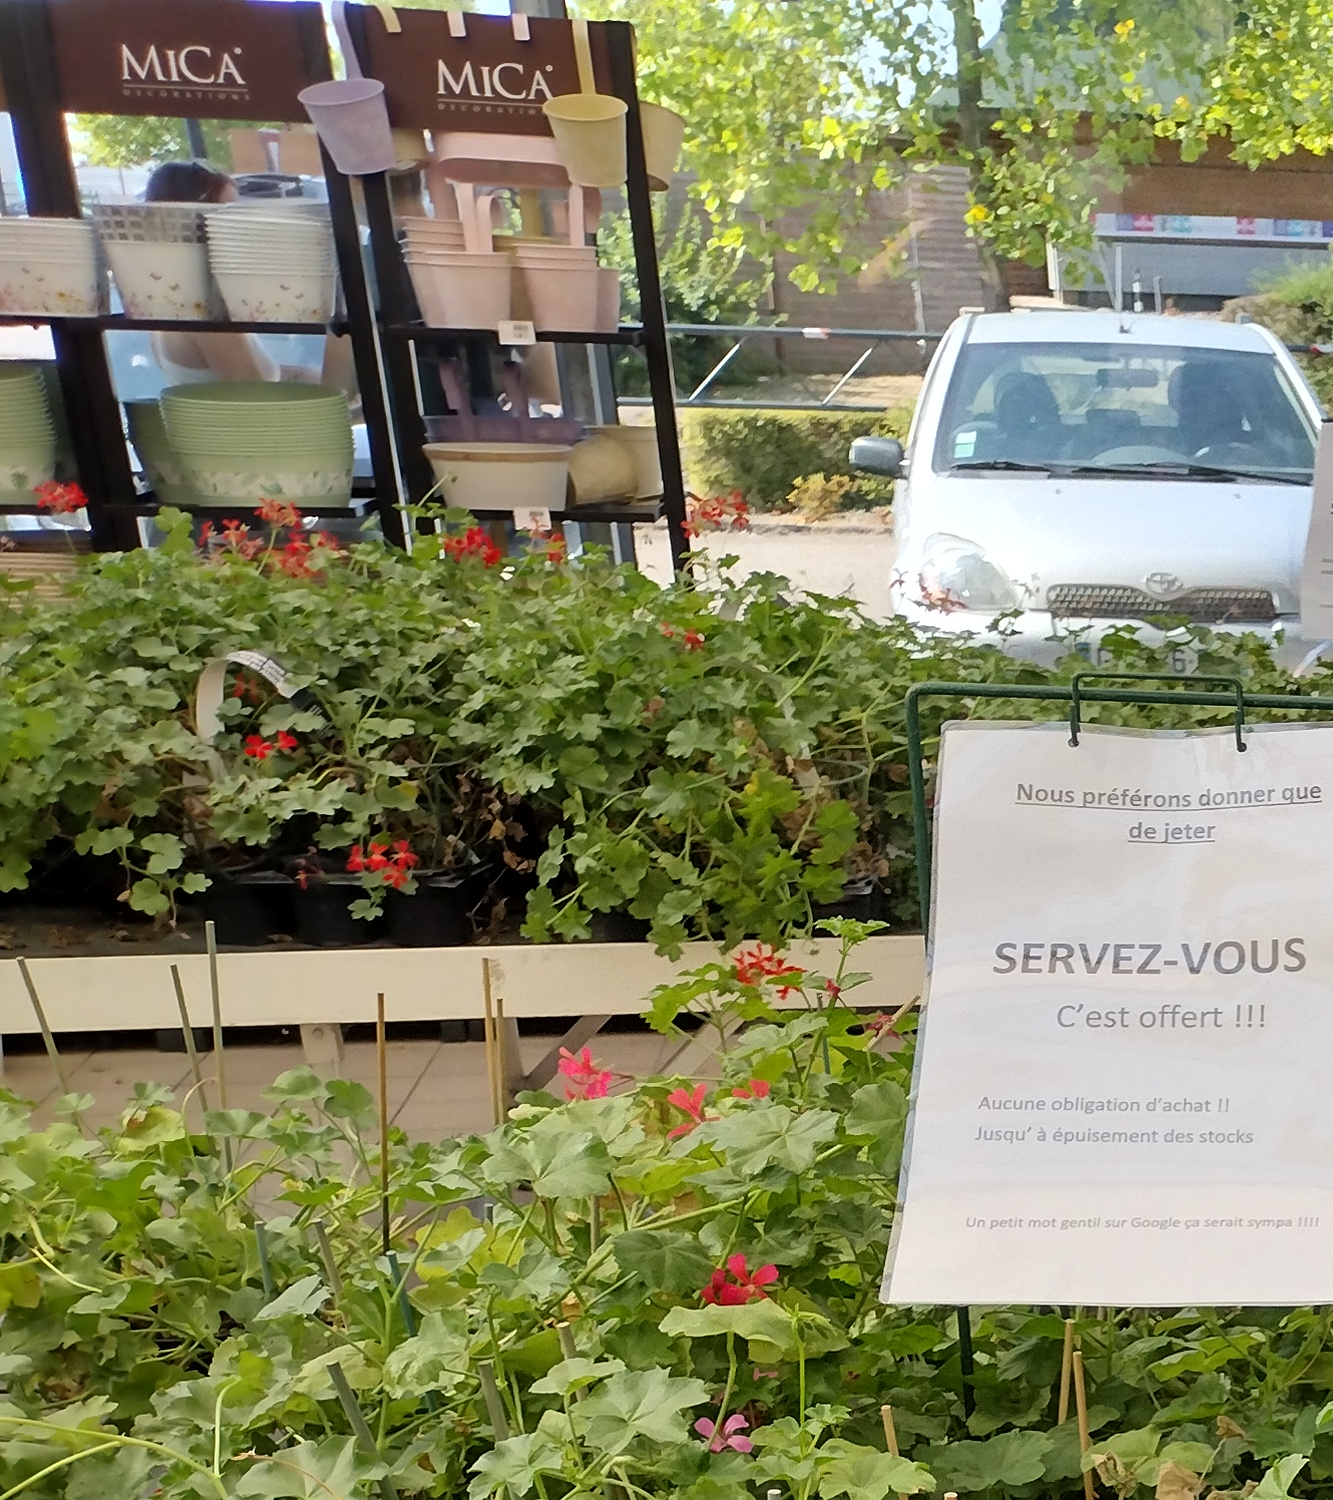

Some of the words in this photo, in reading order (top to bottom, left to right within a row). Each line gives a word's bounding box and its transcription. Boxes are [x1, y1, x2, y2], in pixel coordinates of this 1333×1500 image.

[1016, 783, 1074, 803] Nous
[1082, 787, 1191, 809] préférons
[1200, 786, 1275, 806] donner
[1281, 783, 1322, 803] que
[1128, 822, 1157, 839] de
[1162, 823, 1216, 842] jeter
[993, 937, 1307, 975] SERVEZ-VOUS
[1056, 1003, 1130, 1028] C'est
[1139, 1004, 1223, 1028] offert
[1235, 1004, 1266, 1028] !!!
[978, 1096, 1046, 1110] Aucune
[1051, 1097, 1140, 1114] obligation
[1146, 1097, 1211, 1113] d'achat
[1217, 1098, 1230, 1113] !!
[975, 1126, 1032, 1142] Jusqu'
[1037, 1126, 1047, 1141] à
[1052, 1127, 1159, 1145] épuisement
[1164, 1129, 1194, 1143] des
[1199, 1129, 1254, 1144] stocks
[966, 1217, 985, 1228] Un
[989, 1217, 1024, 1229] petit
[1028, 1217, 1057, 1228] mot
[1060, 1217, 1101, 1230] gentil
[1105, 1219, 1127, 1228] sur
[1131, 1217, 1181, 1230] Google
[1184, 1218, 1200, 1230] ça
[1204, 1217, 1244, 1228] serait
[1248, 1218, 1293, 1229] sympa
[1298, 1217, 1319, 1228] !!!!
